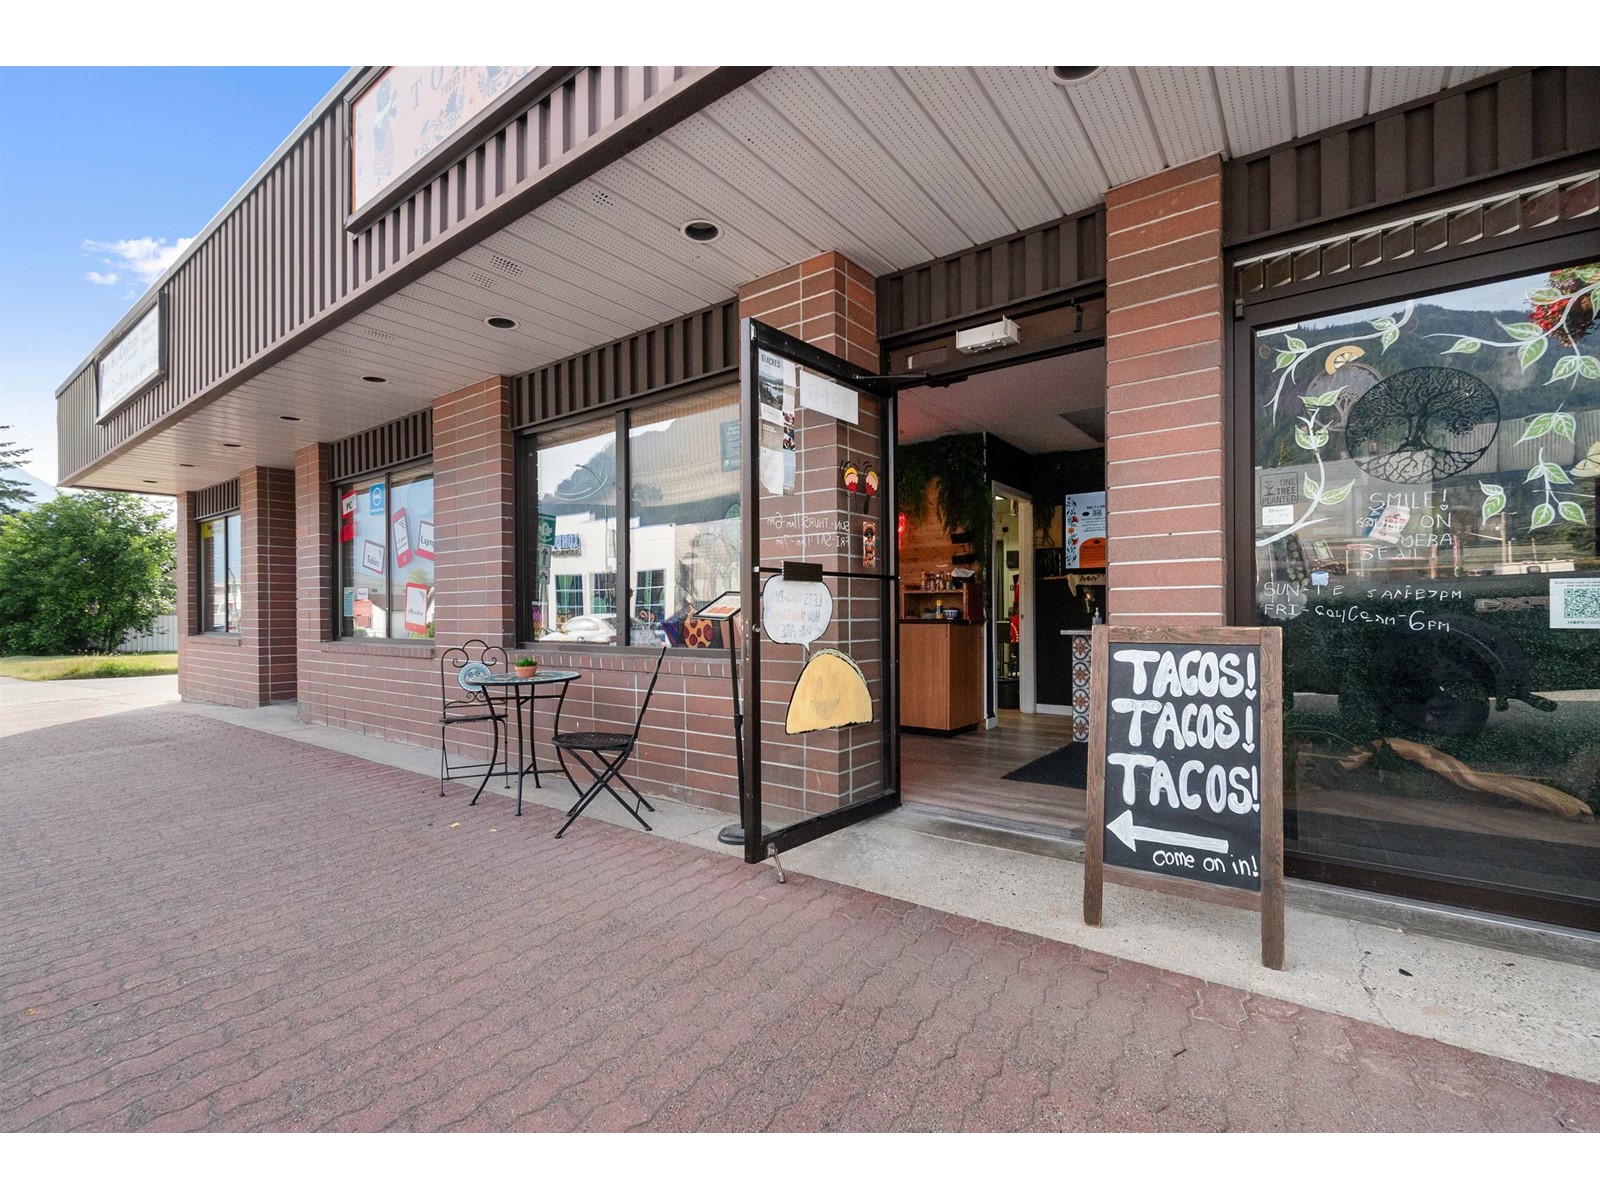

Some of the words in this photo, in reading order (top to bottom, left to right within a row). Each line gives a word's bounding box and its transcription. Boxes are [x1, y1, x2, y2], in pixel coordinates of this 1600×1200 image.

[1276, 487, 1296, 495] TREE
[1280, 478, 1296, 486] ONE
[1262, 495, 1297, 504] PLANTED
[1420, 513, 1451, 528] ON
[1113, 650, 1256, 700] TACOS!
[1111, 698, 1255, 753] TACOS!
[1107, 752, 1260, 815] TACOS!
[1203, 854, 1226, 873] on
[1230, 854, 1259, 877] in!
